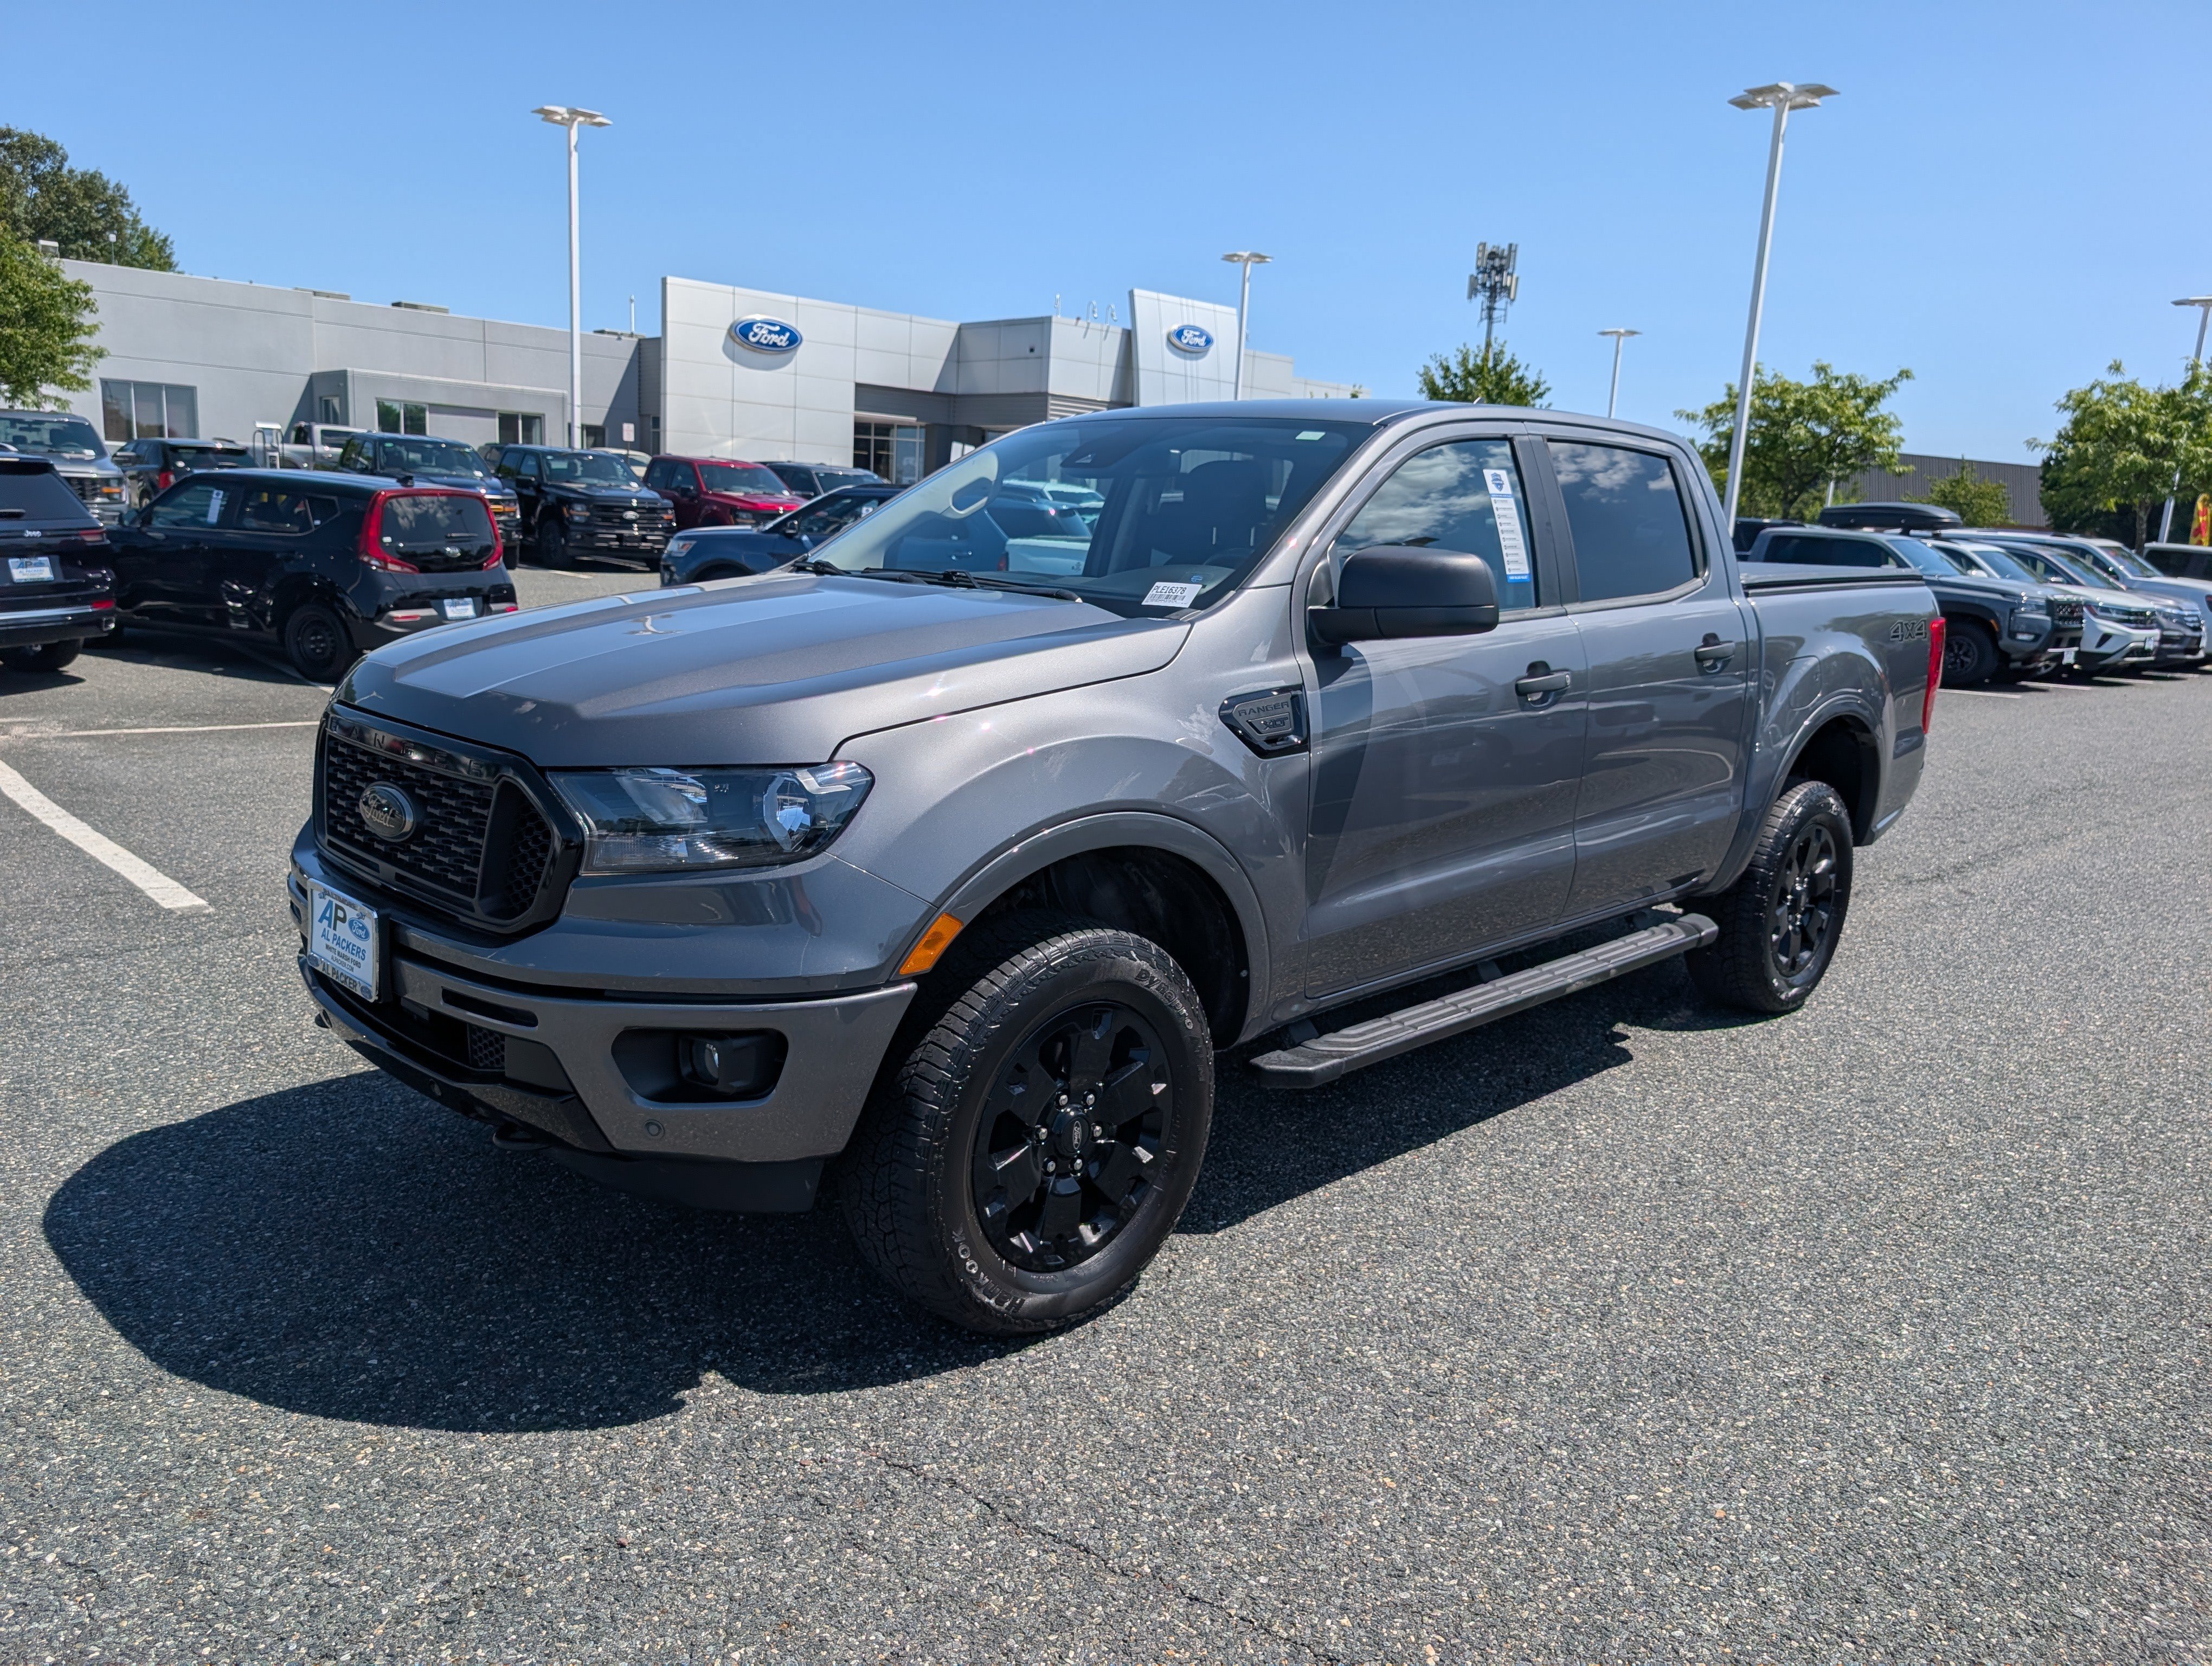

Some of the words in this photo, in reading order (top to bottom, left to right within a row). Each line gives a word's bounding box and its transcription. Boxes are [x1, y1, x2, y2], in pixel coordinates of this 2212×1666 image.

[748, 322, 790, 347] Ford
[1181, 329, 1207, 347] Ford
[1151, 585, 1187, 594] PLE16378
[1238, 701, 1289, 717] RANGER
[1262, 716, 1289, 731] XLT
[330, 716, 484, 777] RANGER
[362, 791, 395, 828] Ford
[318, 899, 348, 932] AP
[352, 920, 366, 939] Ford
[321, 928, 330, 943] AL
[332, 934, 366, 962] PACKERS
[325, 944, 337, 955] WHITE
[337, 950, 350, 963] MARSH
[350, 957, 362, 969] FORD
[331, 954, 355, 972] ALPACKER.COM
[1134, 968, 1193, 1030] Dynapro
